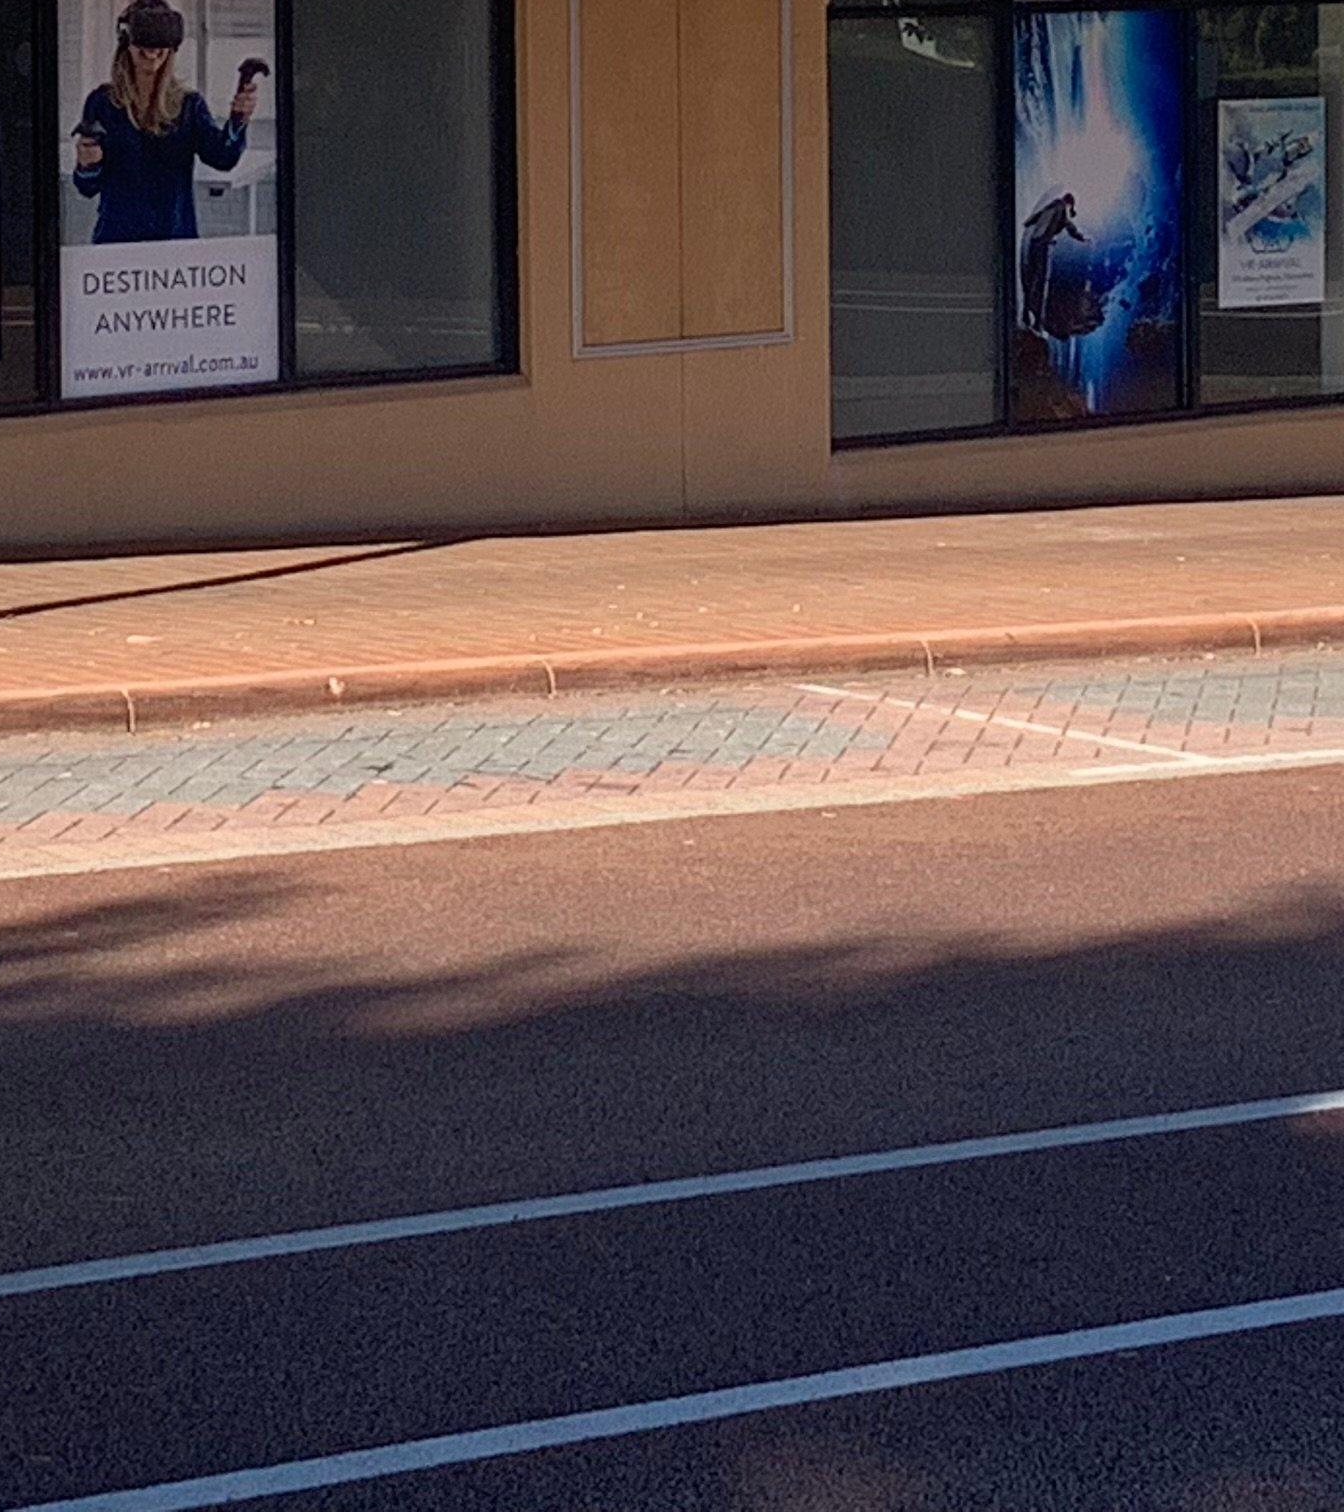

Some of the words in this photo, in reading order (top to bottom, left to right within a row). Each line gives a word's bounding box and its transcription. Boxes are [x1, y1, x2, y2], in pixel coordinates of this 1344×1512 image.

[82, 263, 247, 296] DESTINATION
[94, 303, 237, 335] ANYWHERE
[72, 353, 259, 382] www.vr-arrival.com.au
